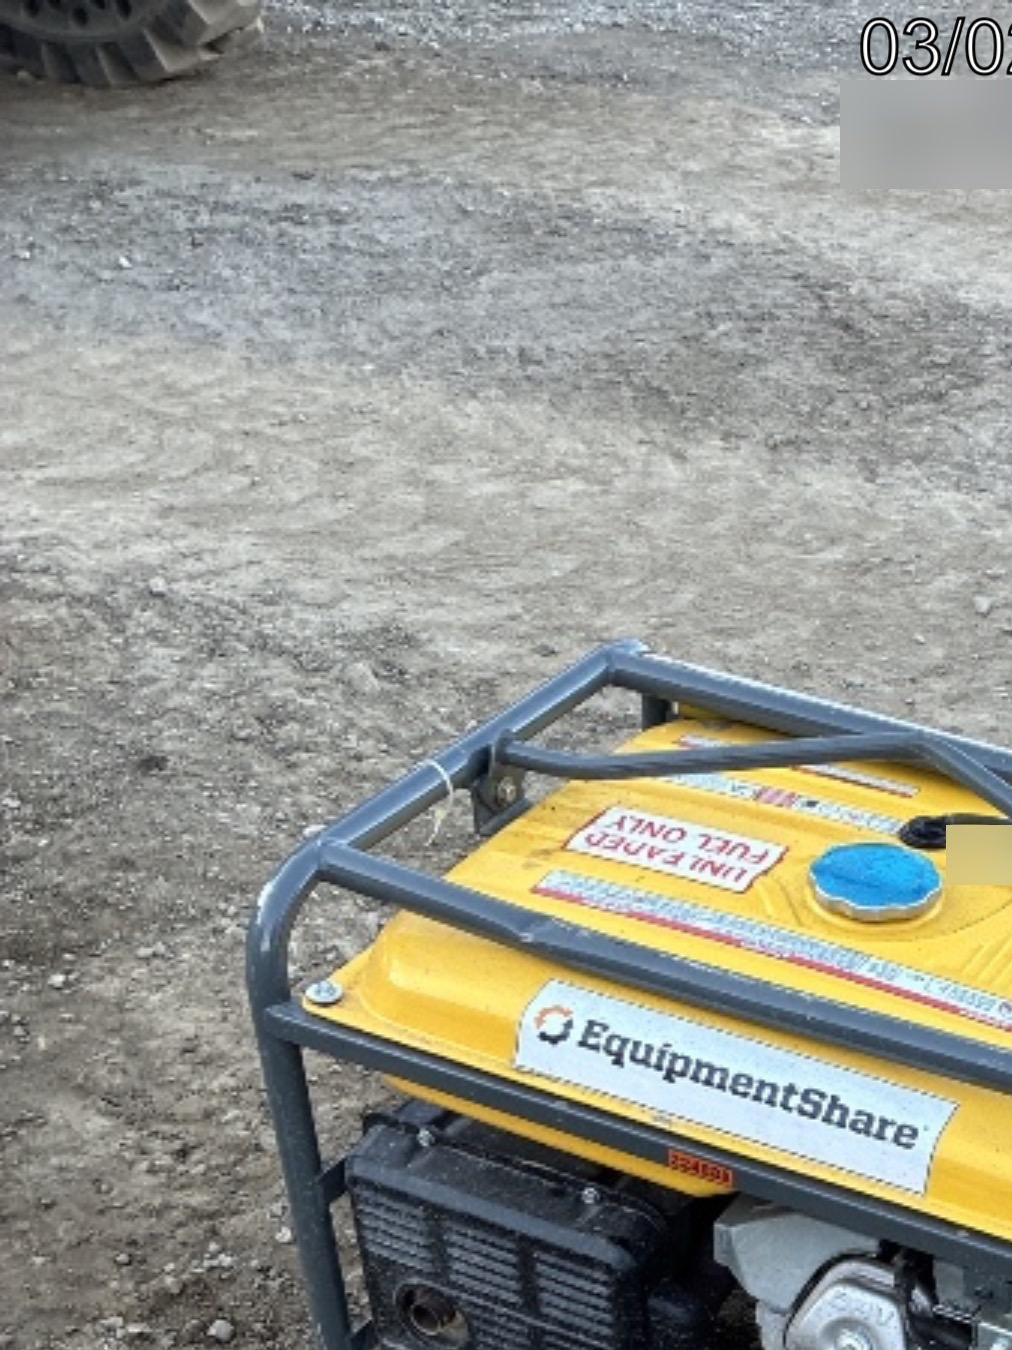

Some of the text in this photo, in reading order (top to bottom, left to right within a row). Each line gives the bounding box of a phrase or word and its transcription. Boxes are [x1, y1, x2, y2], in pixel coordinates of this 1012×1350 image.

[584, 831, 748, 883] UNLEADED
[611, 815, 770, 865] FUEL ONLY
[577, 1019, 919, 1150] EquipmentShare
